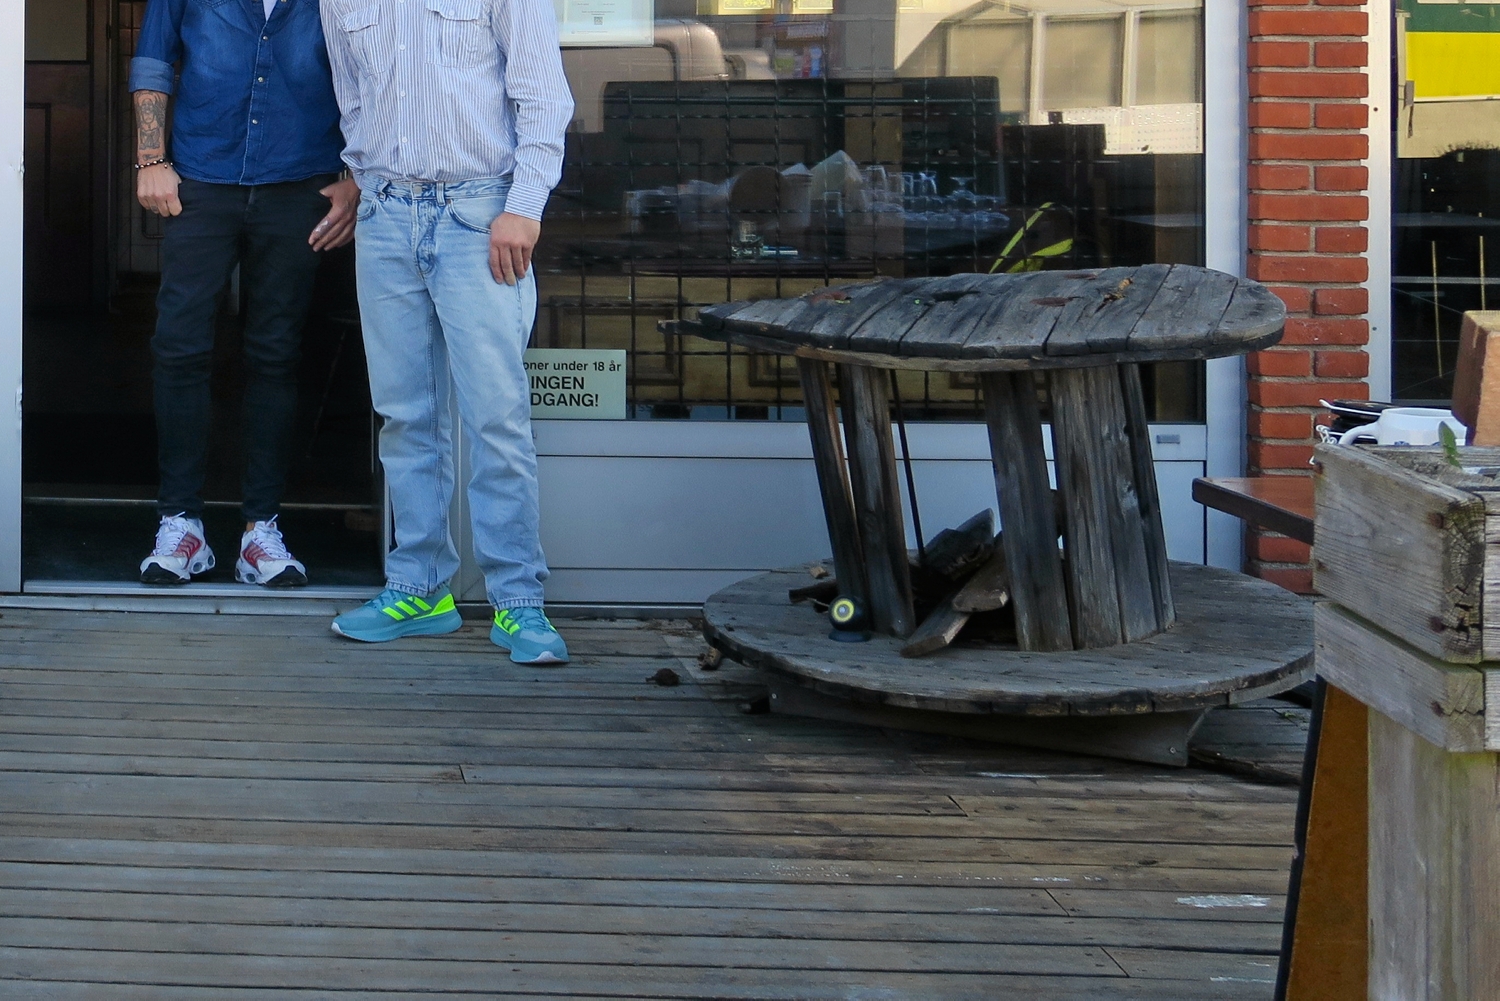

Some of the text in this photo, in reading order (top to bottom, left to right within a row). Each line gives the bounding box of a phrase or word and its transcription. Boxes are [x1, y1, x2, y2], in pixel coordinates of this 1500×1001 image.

[523, 359, 622, 372] oner under 18 år
[531, 376, 585, 390] INGEN
[530, 393, 599, 407] DGANG!
